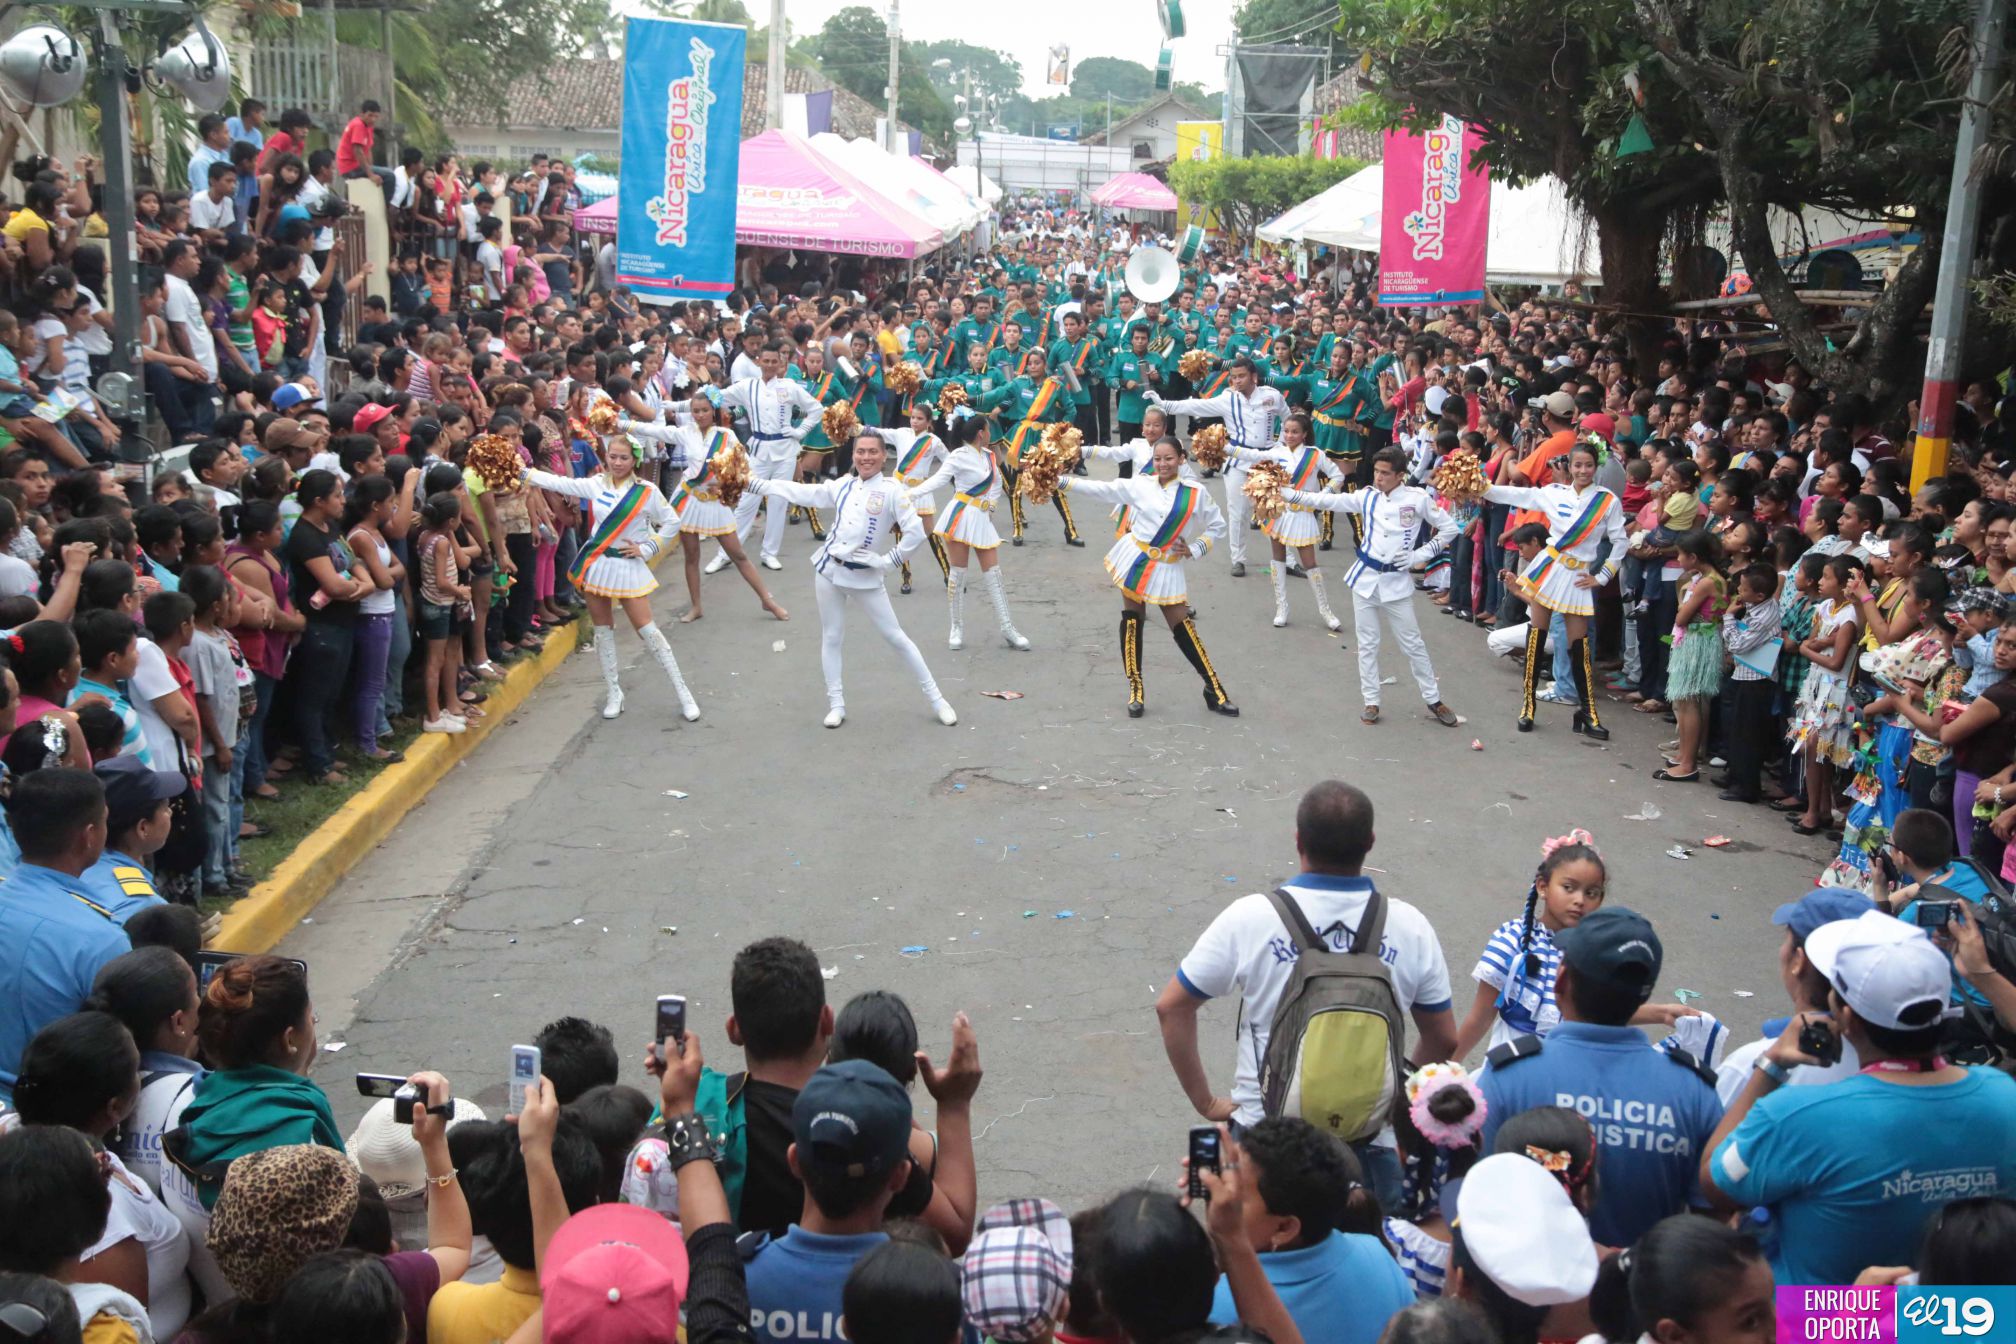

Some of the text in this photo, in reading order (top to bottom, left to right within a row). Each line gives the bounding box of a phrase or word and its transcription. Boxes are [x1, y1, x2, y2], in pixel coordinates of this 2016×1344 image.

[660, 80, 694, 243] Nicaragua
[583, 217, 617, 231] INST
[804, 236, 826, 249] DE
[832, 239, 904, 256] TURISMO
[1392, 284, 1418, 292] TURISMO
[1556, 1092, 1676, 1129] POLICIA
[1590, 1123, 1690, 1157] ISTICA
[1882, 1170, 1998, 1199] Nicaragua
